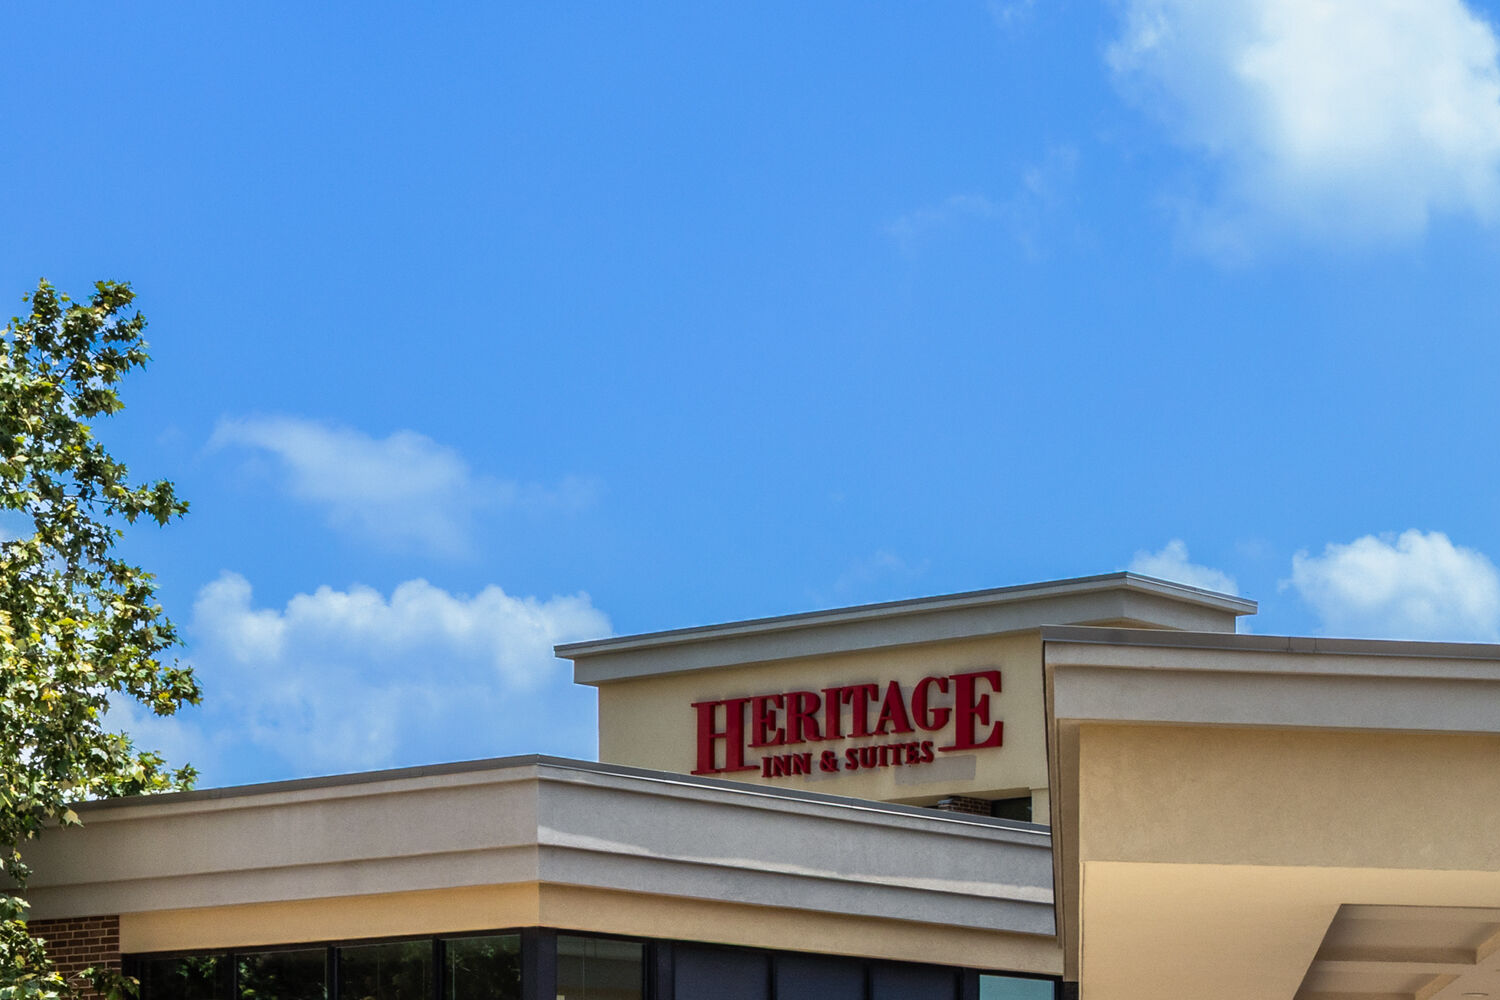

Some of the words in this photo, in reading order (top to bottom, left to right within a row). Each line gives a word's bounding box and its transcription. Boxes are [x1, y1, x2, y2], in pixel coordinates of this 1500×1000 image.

[691, 670, 1004, 775] HERITAGE
[762, 752, 813, 778] INN
[819, 750, 840, 773] &
[845, 741, 934, 771] SUITES
